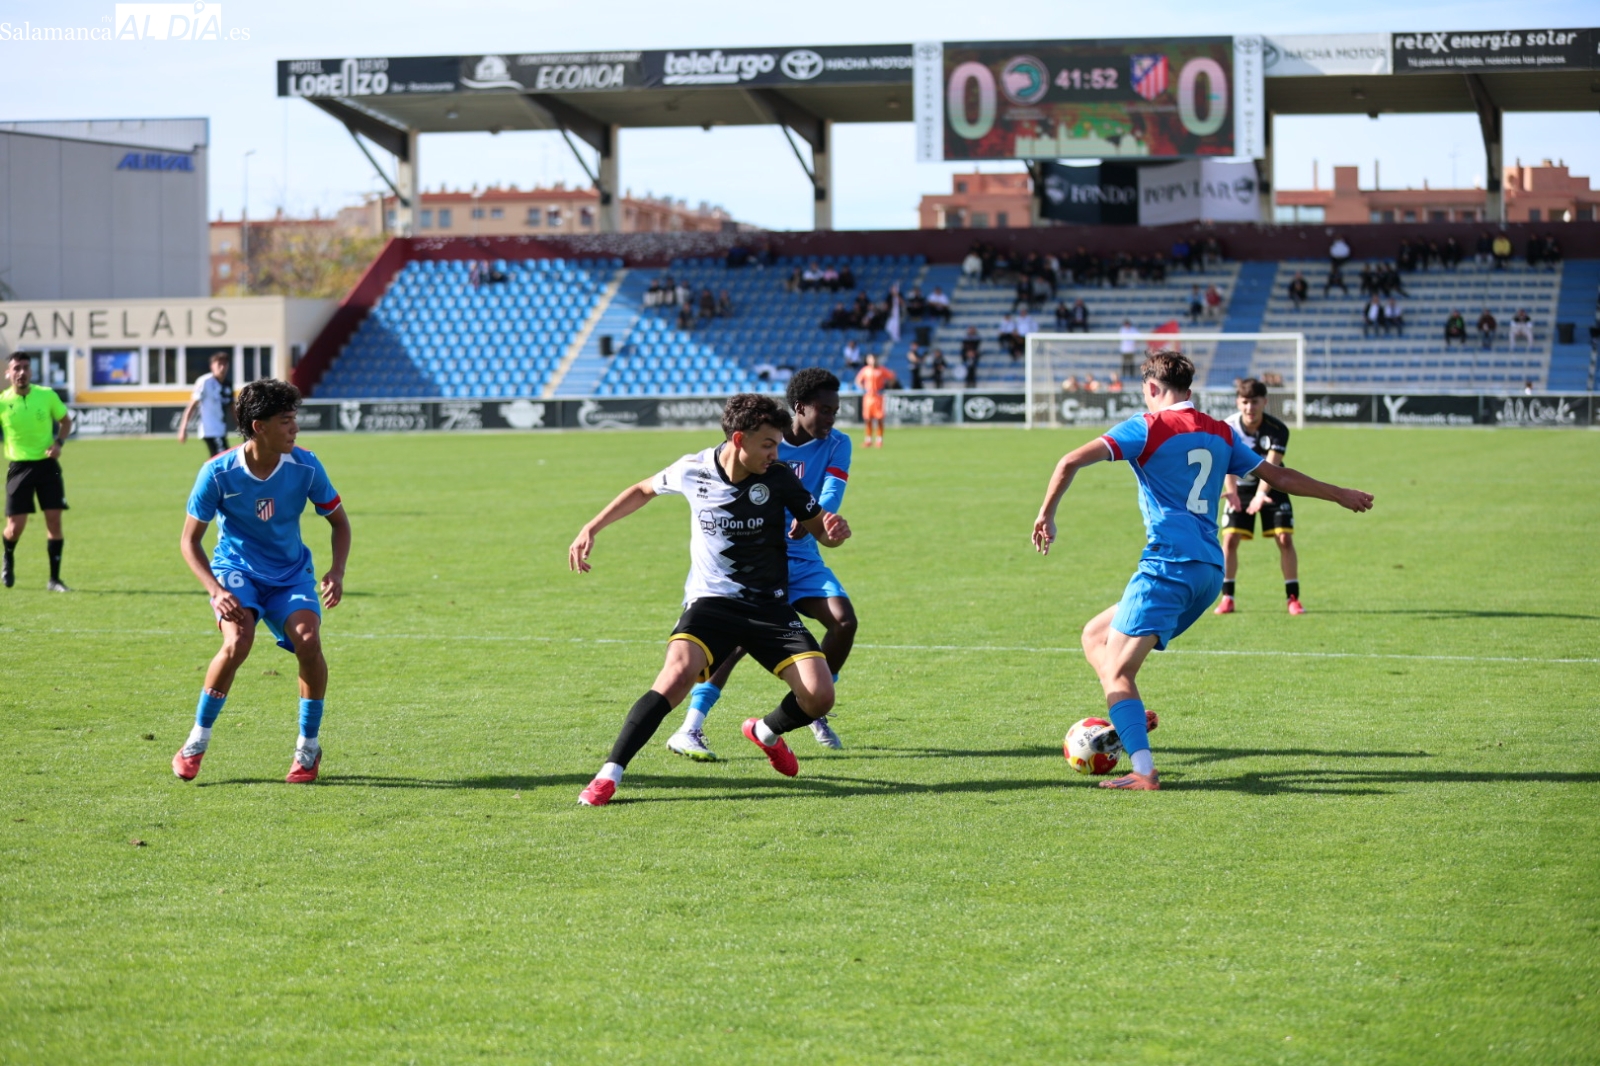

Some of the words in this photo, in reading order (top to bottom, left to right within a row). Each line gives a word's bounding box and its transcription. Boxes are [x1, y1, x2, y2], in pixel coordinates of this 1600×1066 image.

[1526, 30, 1578, 47] solar
[289, 60, 324, 73] HOTEL
[536, 62, 625, 90] ECONOA
[663, 50, 776, 80] telefurgo
[1054, 67, 1119, 90] 41:52
[947, 60, 997, 140] 0
[1177, 56, 1228, 137] 0
[77, 407, 148, 425] MIRSAN
[1186, 448, 1213, 515] 2
[721, 517, 744, 529] Don
[747, 517, 764, 530] QR
[227, 570, 245, 588] 6
